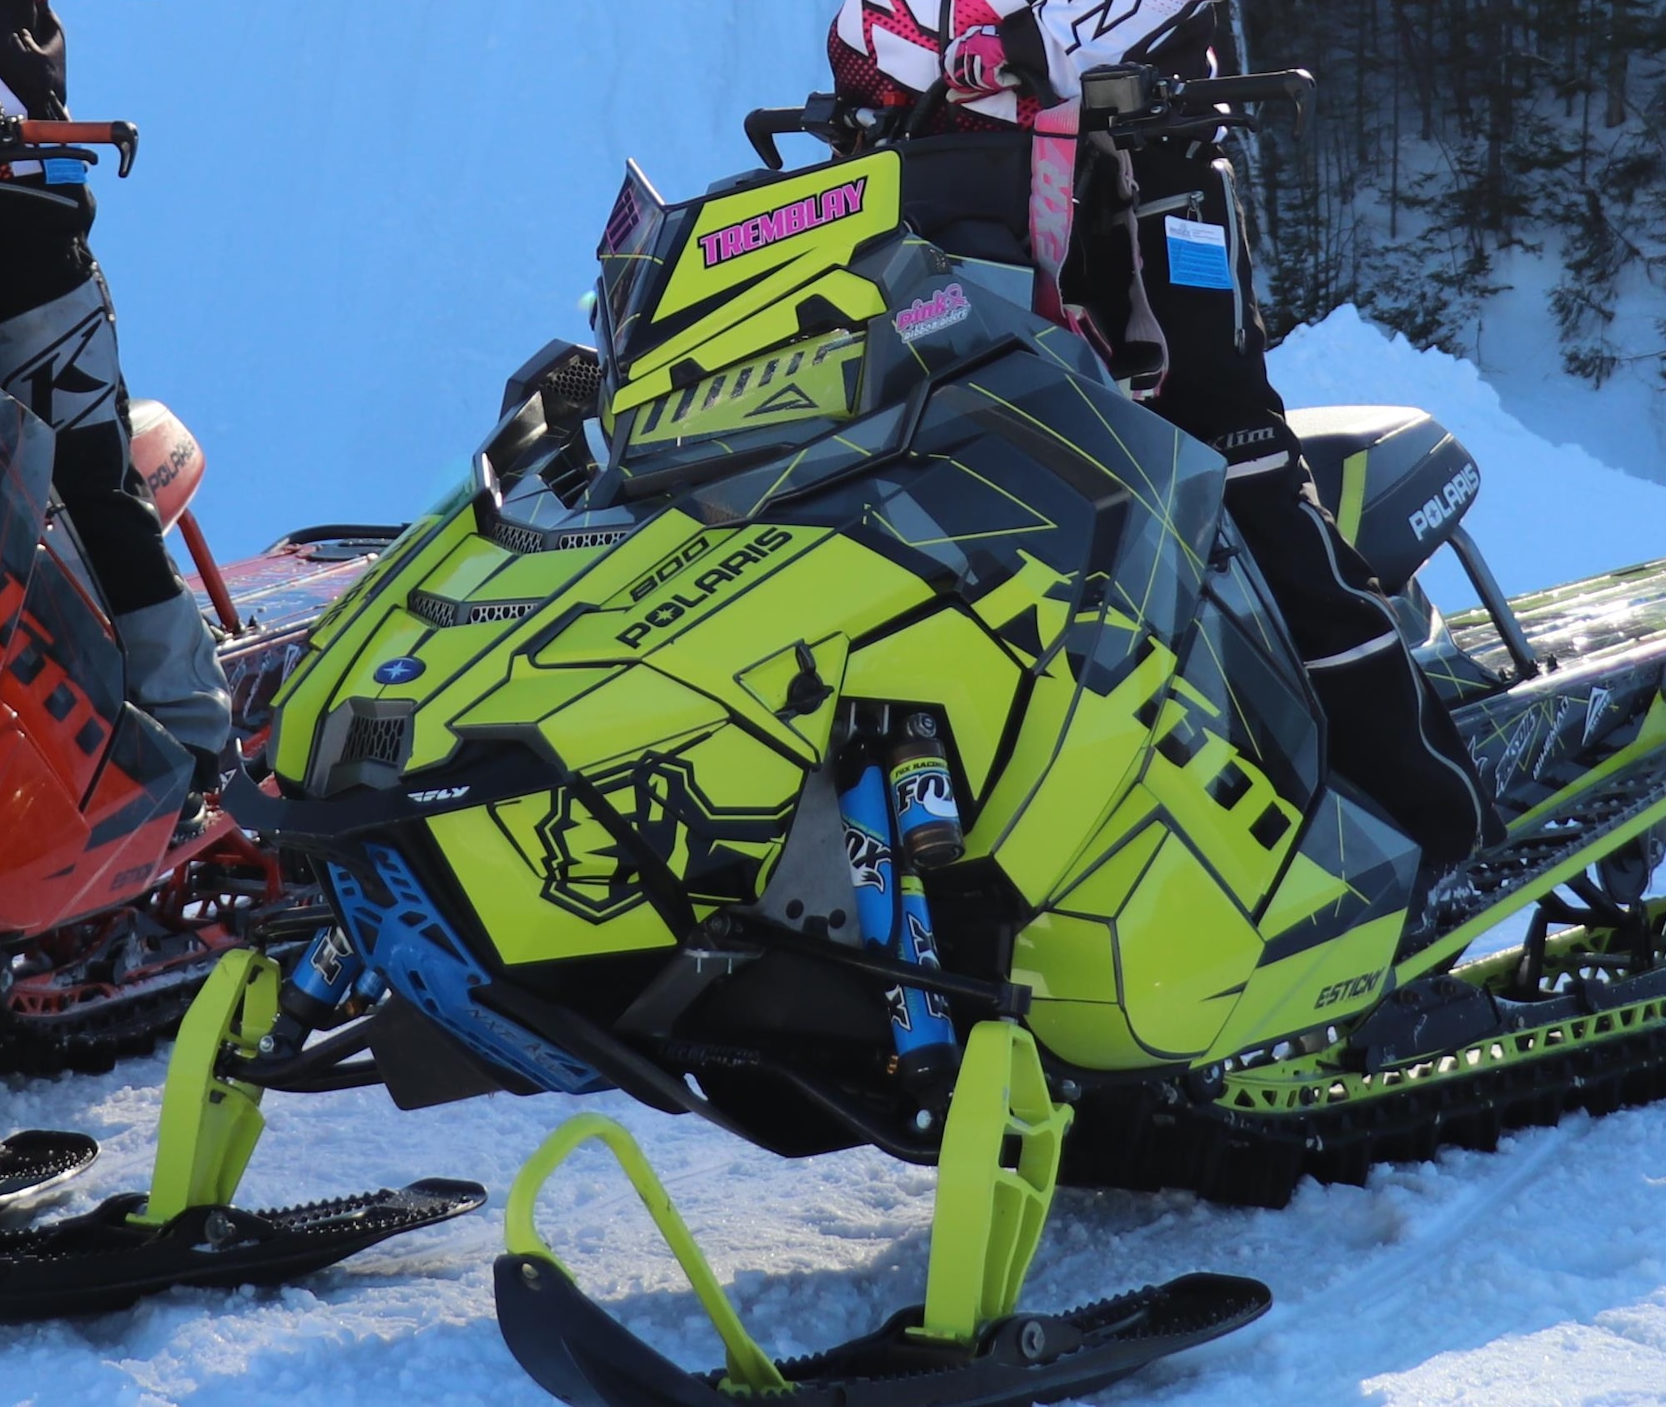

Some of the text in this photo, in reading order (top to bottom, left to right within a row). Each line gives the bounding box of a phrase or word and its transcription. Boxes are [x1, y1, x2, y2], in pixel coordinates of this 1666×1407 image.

[699, 176, 868, 267] TREMBLAY
[1408, 462, 1479, 541] POLARIS
[616, 526, 793, 649] POLARIS
[630, 536, 709, 602] 800
